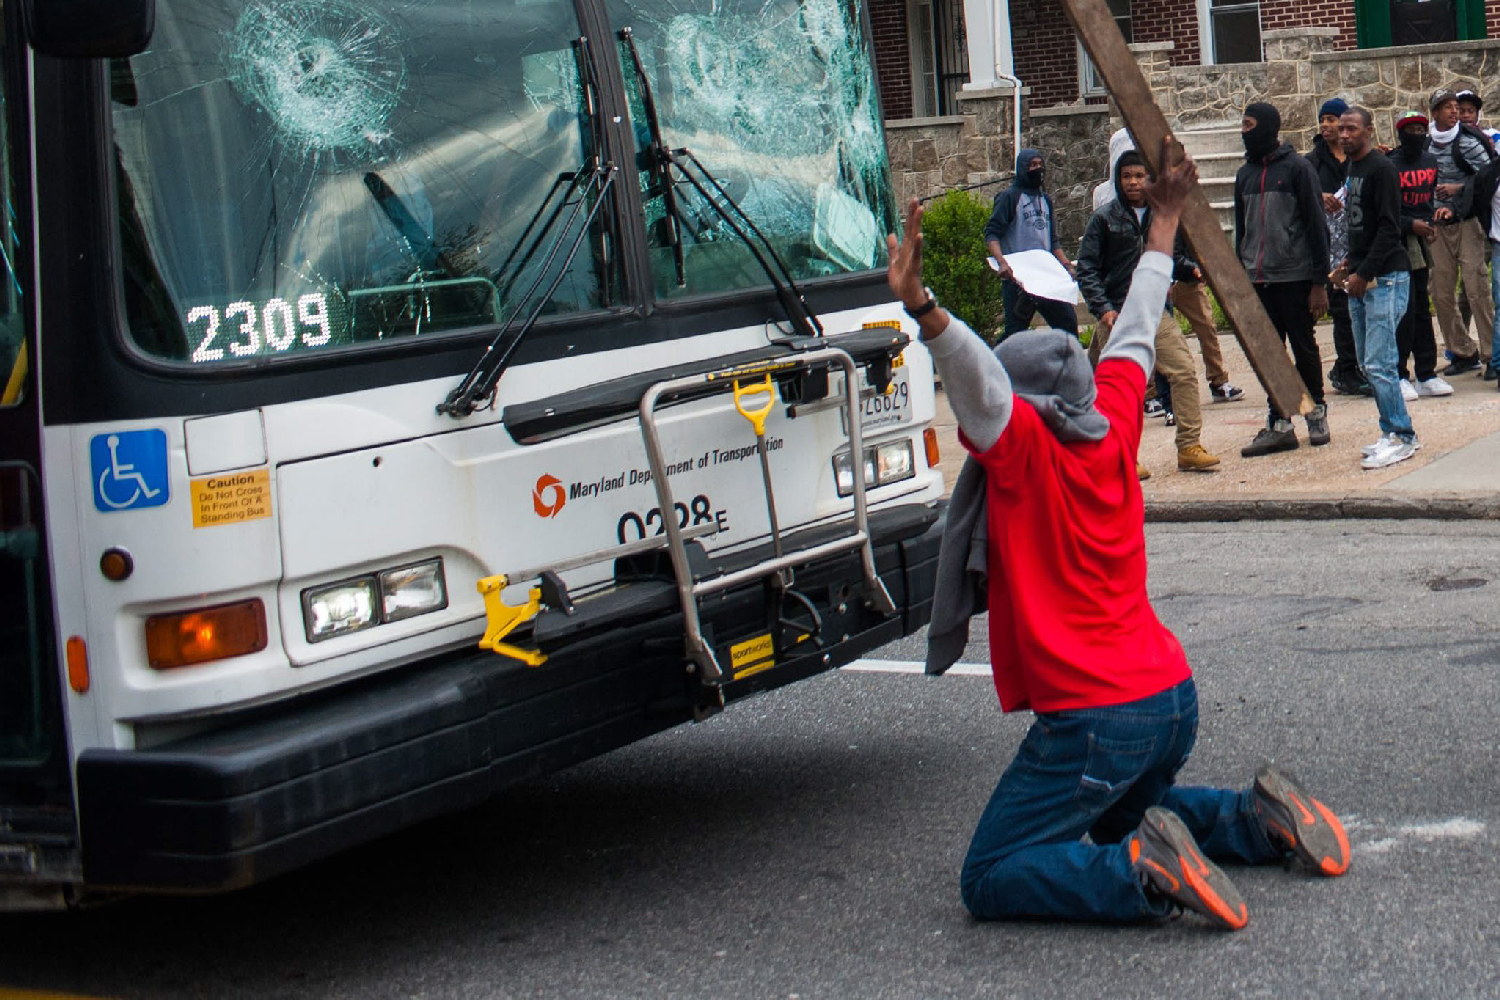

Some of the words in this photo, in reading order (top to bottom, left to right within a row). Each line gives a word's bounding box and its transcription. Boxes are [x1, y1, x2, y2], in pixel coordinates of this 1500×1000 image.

[186, 292, 331, 363] 2309
[569, 471, 625, 500] Maryland
[698, 451, 709, 468] of
[712, 437, 784, 463] Transporttion
[207, 475, 255, 489] Caution
[199, 493, 214, 502] Do
[216, 490, 233, 500] Not
[236, 486, 263, 496] Cross
[200, 504, 211, 512] In
[212, 500, 238, 511] Front
[200, 510, 245, 523] Standing
[247, 507, 265, 516] Bus
